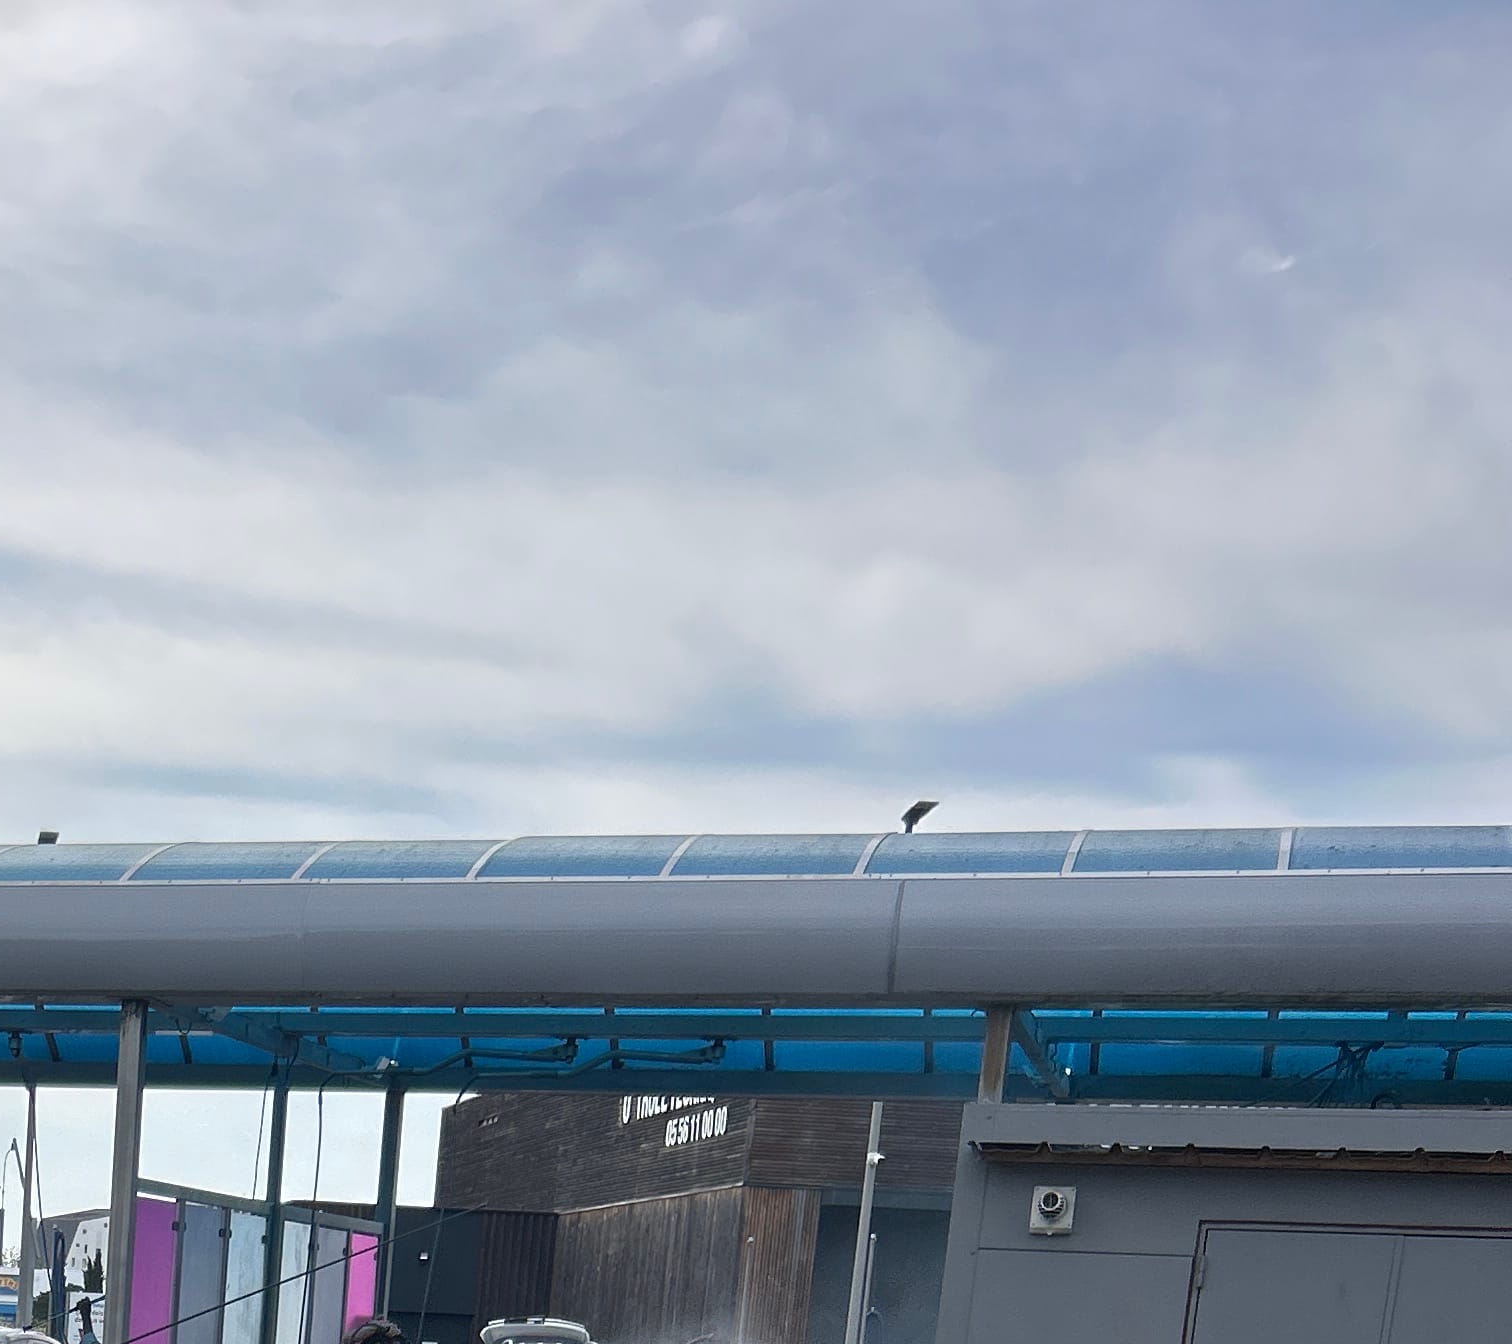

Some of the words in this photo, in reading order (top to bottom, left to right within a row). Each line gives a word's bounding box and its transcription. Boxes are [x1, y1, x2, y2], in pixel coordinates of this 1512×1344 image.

[691, 1113, 700, 1142] 11
[702, 1109, 714, 1139] 00
[715, 1106, 728, 1136] 00
